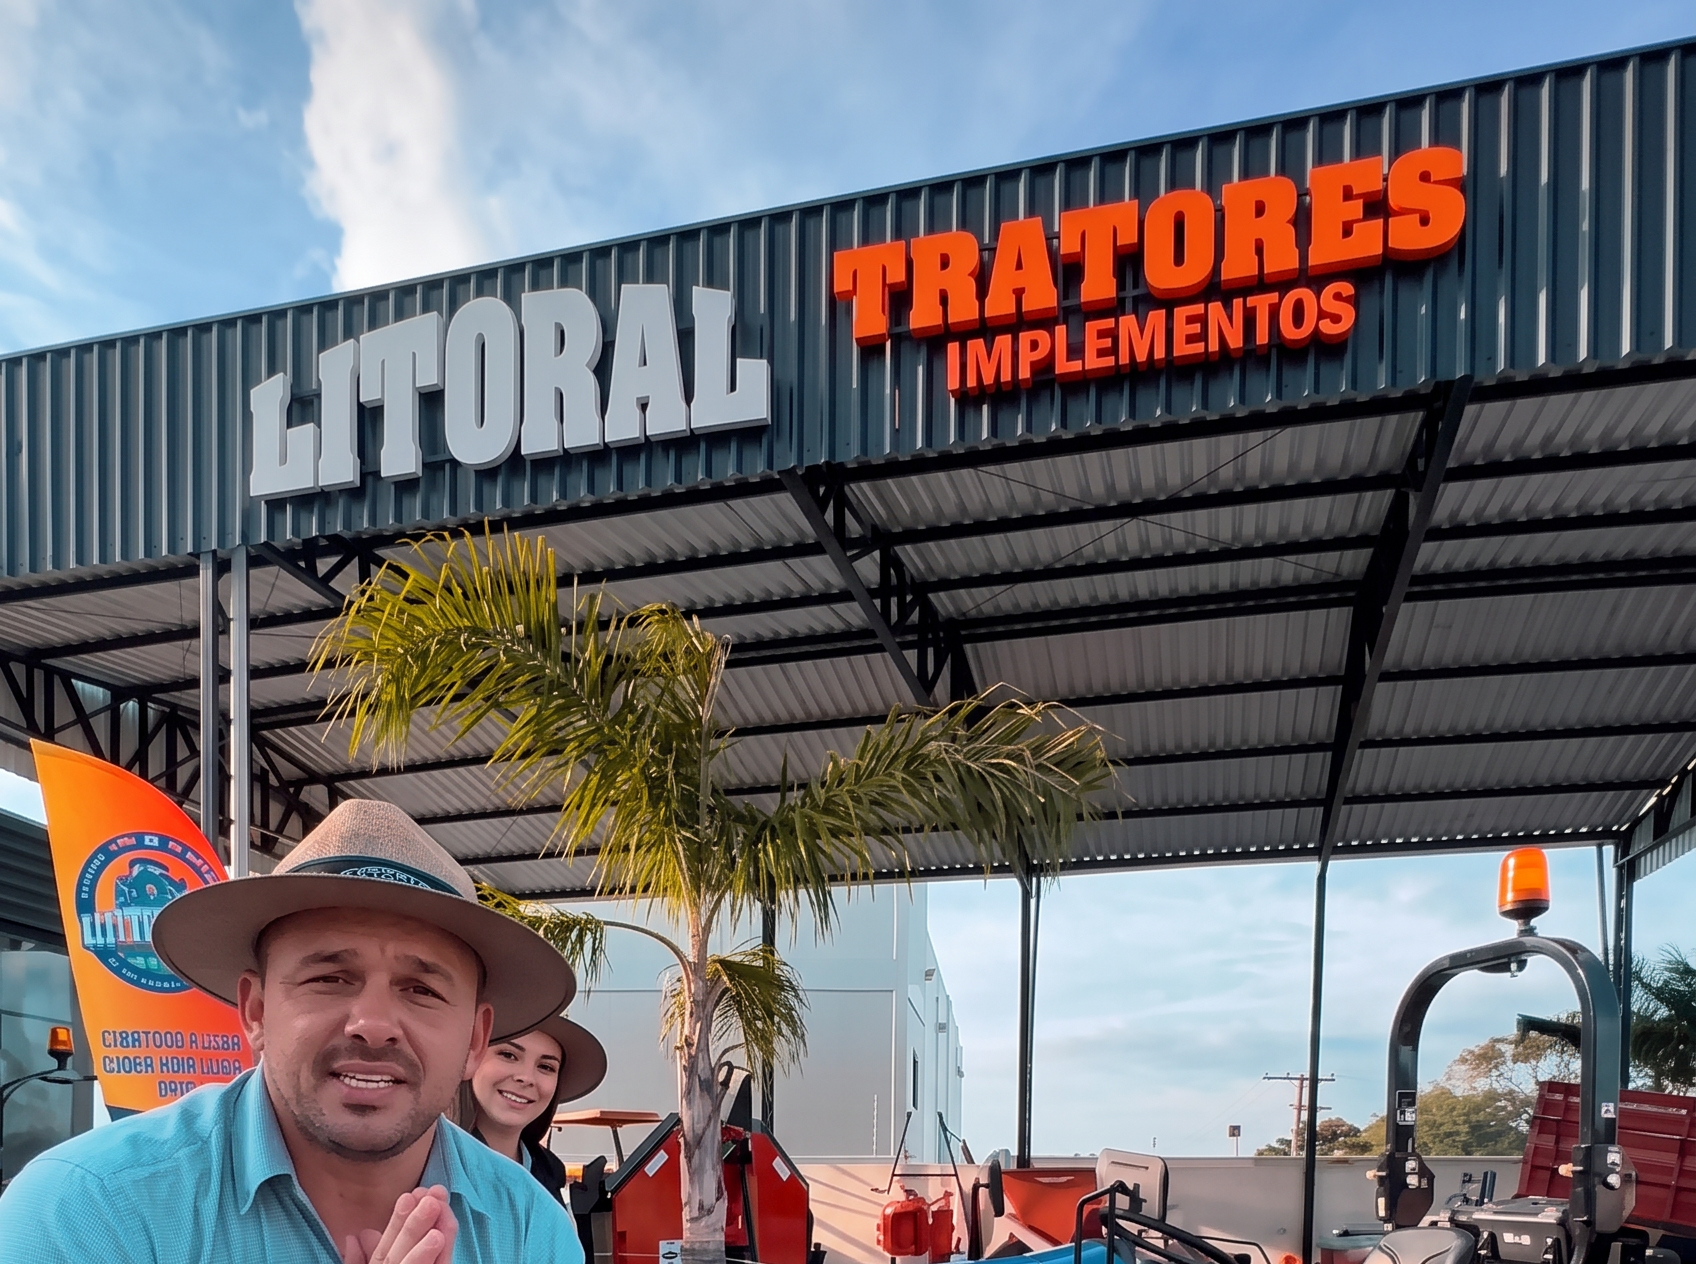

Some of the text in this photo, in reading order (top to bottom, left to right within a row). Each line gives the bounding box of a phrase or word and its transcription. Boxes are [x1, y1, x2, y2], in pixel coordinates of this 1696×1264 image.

[834, 147, 1466, 347] TRATORES
[947, 281, 1356, 397] IMPLEMENTOS
[250, 284, 771, 497] LITORAL
